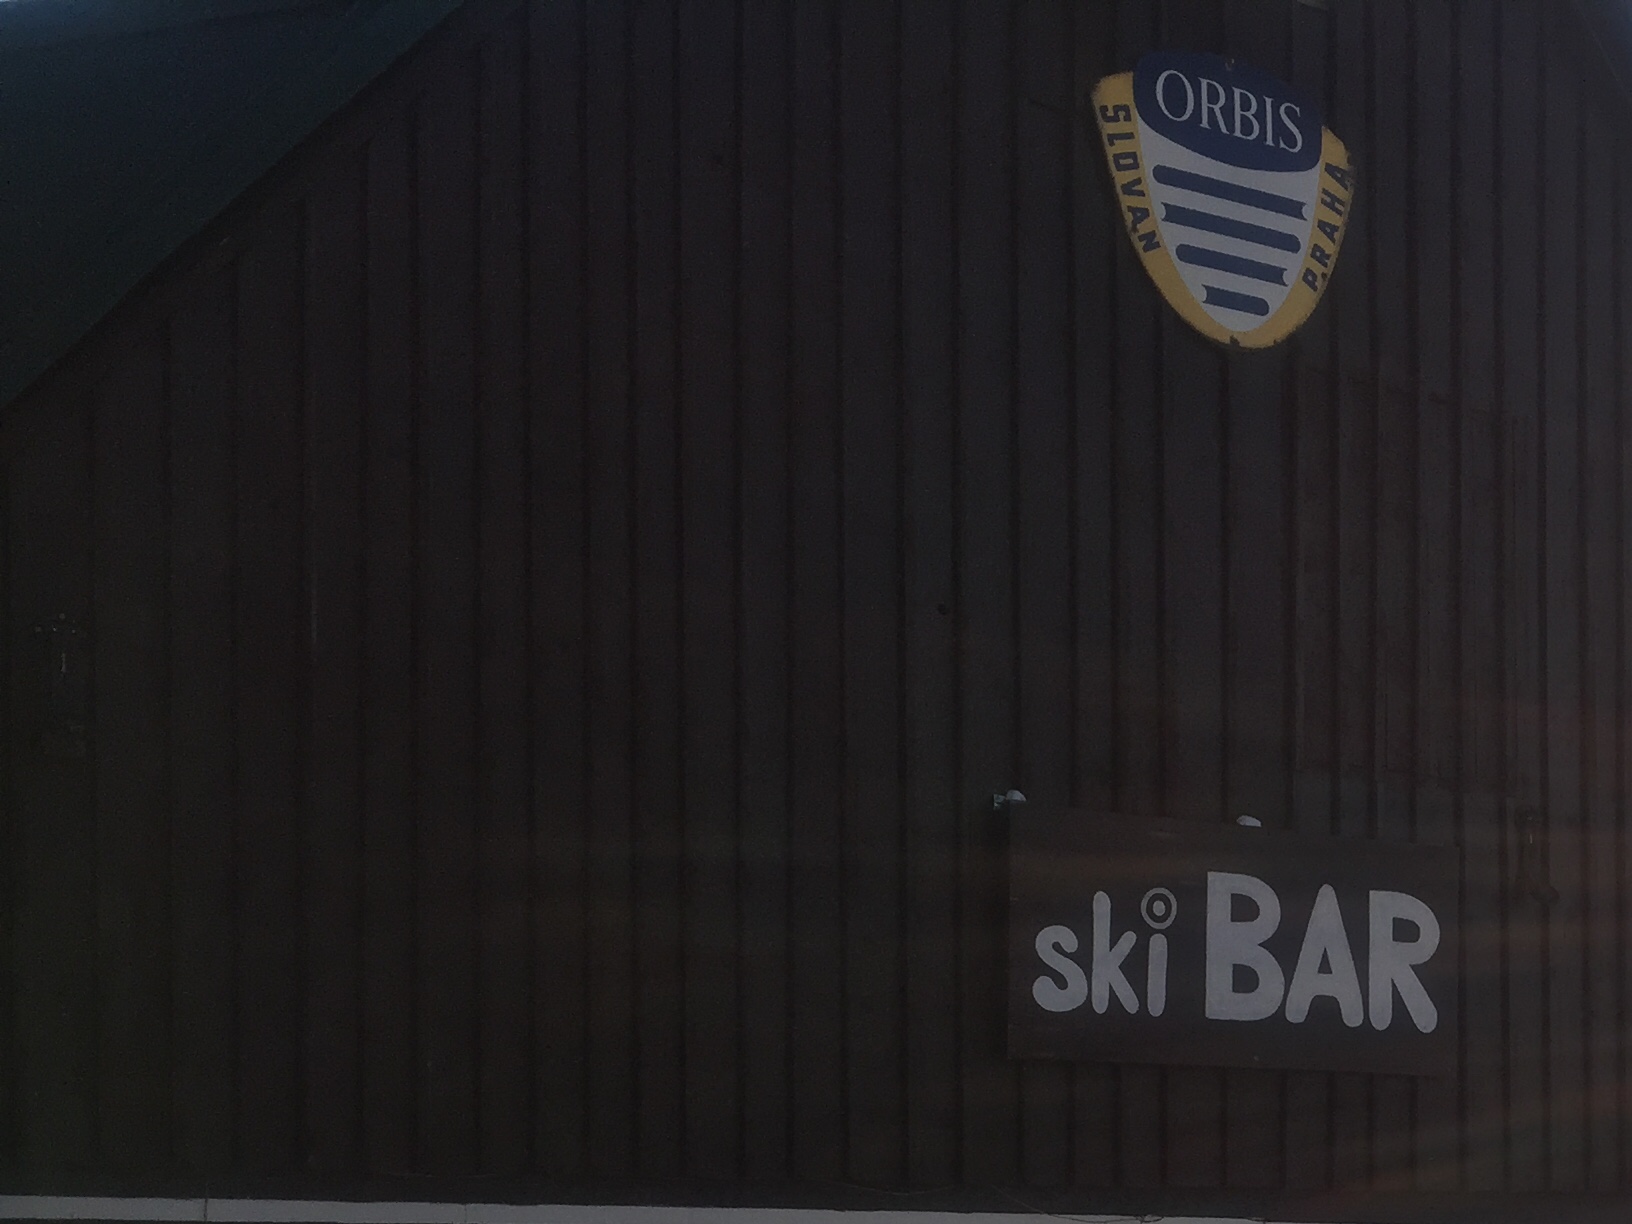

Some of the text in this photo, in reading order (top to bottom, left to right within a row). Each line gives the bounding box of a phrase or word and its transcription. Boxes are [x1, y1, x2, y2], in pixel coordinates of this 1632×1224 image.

[1099, 103, 1162, 253] SLOVAN
[1155, 69, 1304, 153] ORBIS
[1301, 162, 1352, 292] PRAHA
[1032, 871, 1441, 1034] ski BAR
